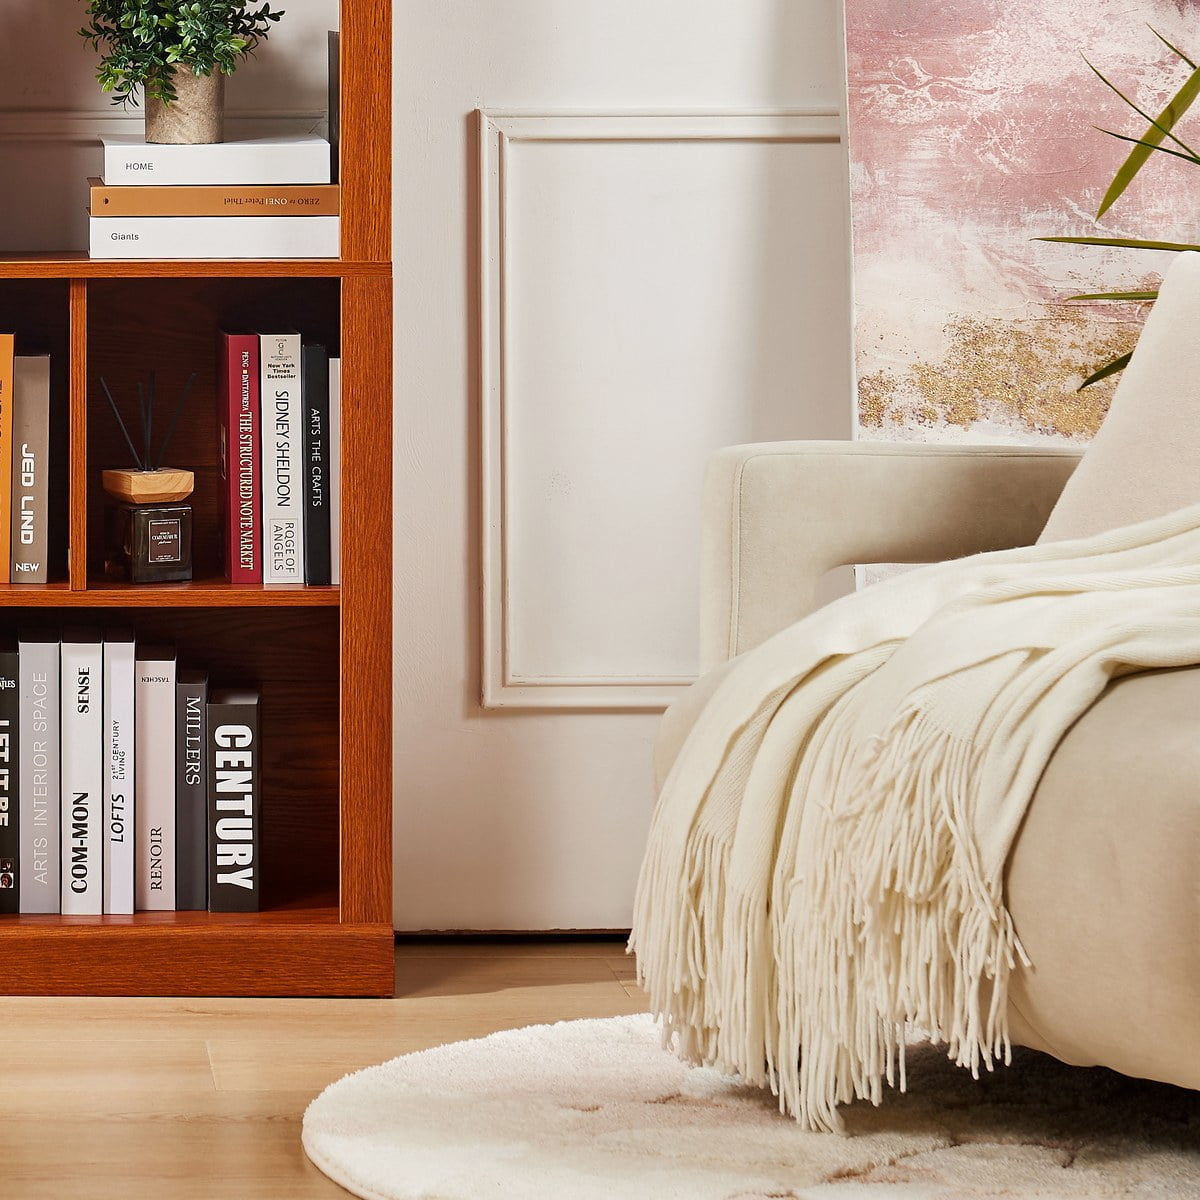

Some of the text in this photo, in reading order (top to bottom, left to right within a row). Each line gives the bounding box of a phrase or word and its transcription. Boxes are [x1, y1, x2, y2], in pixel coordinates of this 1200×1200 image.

[125, 162, 154, 171] HOME
[223, 197, 244, 205] Thiel
[245, 197, 264, 205] Peter
[297, 197, 320, 205] ZERO
[111, 232, 139, 241] Giants
[240, 411, 253, 433] THE
[240, 434, 253, 499] STRUCTURED
[275, 390, 291, 507] SIDNEY SHELDON
[310, 408, 322, 507] ARTS THE CRAFTS
[20, 443, 35, 545] JED LIND
[240, 501, 253, 529] NOTE
[15, 563, 40, 572] NEW
[273, 524, 284, 571] ANGELS
[285, 558, 295, 573] OF
[112, 720, 120, 761] CENTURY
[185, 696, 201, 785] MILLERS
[32, 672, 48, 885] ARTS INTERIOR SPACE
[70, 666, 90, 894] COM-MON SENSE
[118, 750, 126, 780] LIVING
[110, 794, 125, 843] LOFTS
[214, 724, 254, 890] CENTURY
[150, 826, 162, 891] RENOIR
